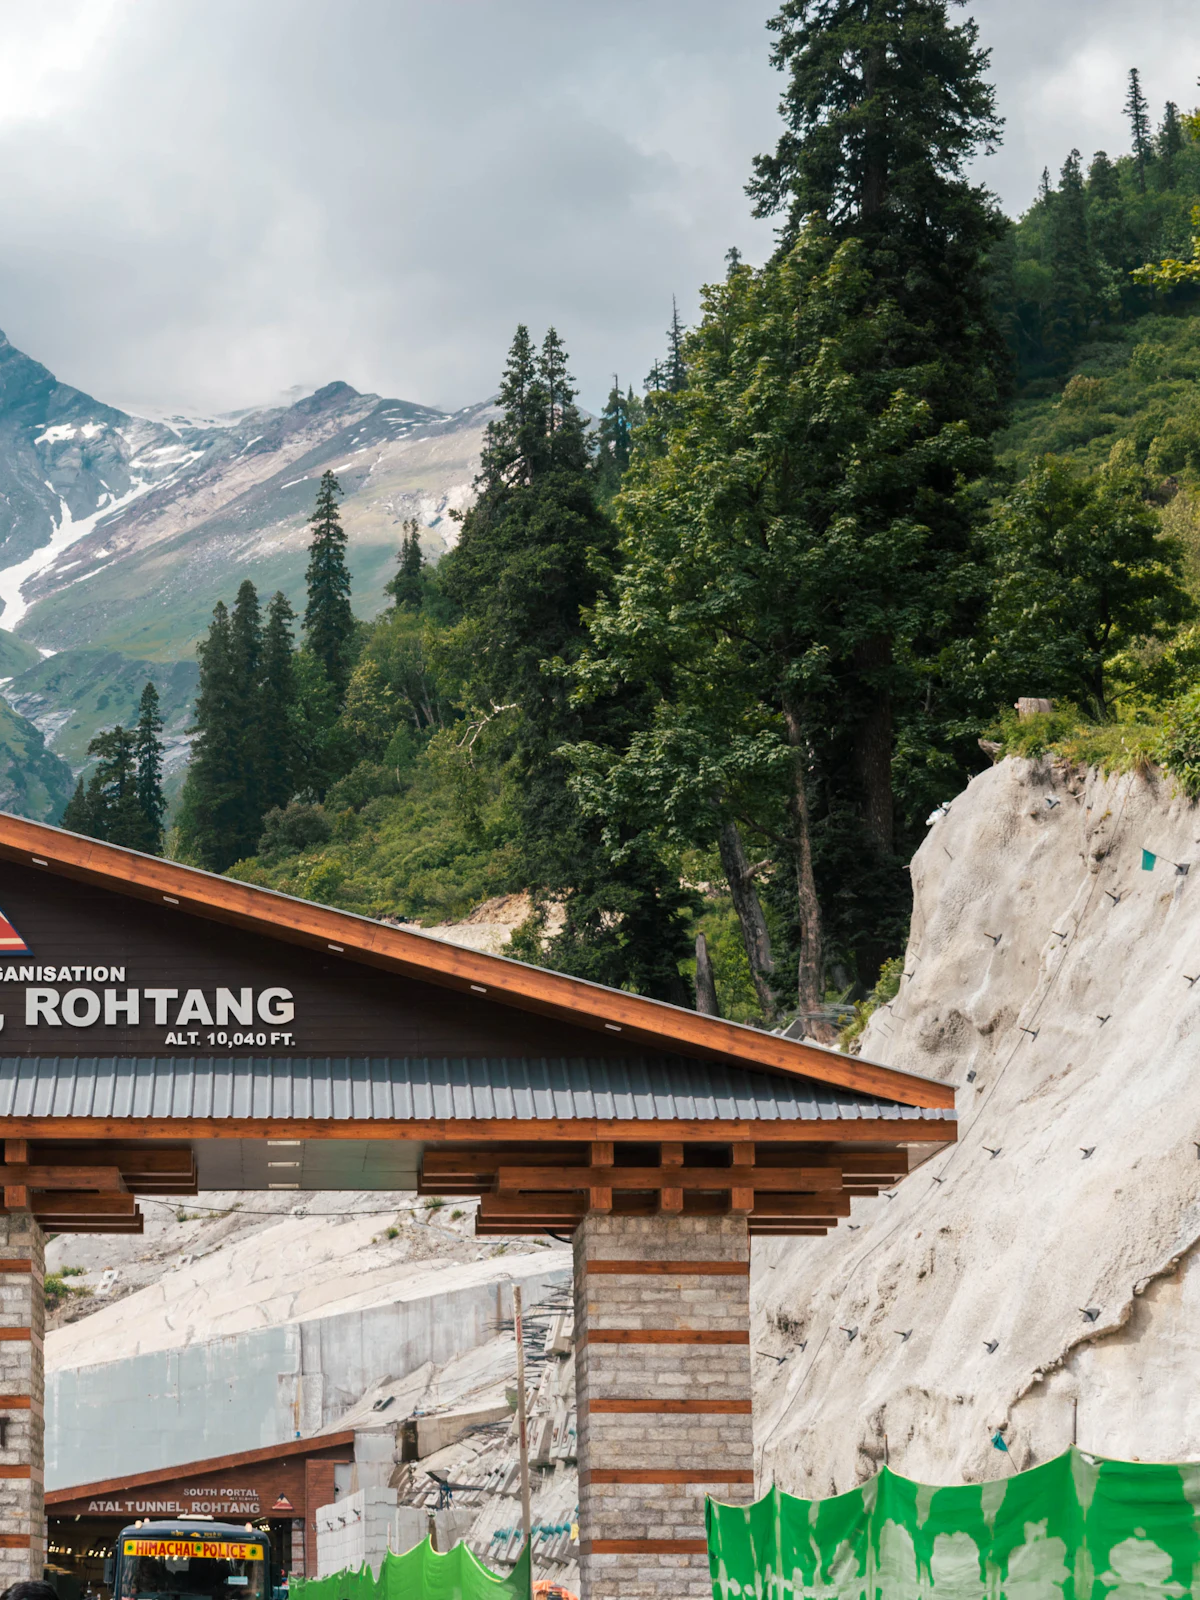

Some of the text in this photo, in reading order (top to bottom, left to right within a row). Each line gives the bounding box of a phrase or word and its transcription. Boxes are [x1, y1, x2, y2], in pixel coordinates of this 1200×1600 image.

[25, 987, 295, 1027] ROHTANG
[164, 1031, 296, 1048] ALT. 10,040 FT.
[183, 1488, 259, 1497] SOUTH PORTAL
[88, 1501, 260, 1515] ATAL TUNNEL, ROHTANG
[135, 1540, 246, 1558] HIMACHAL POLICE
